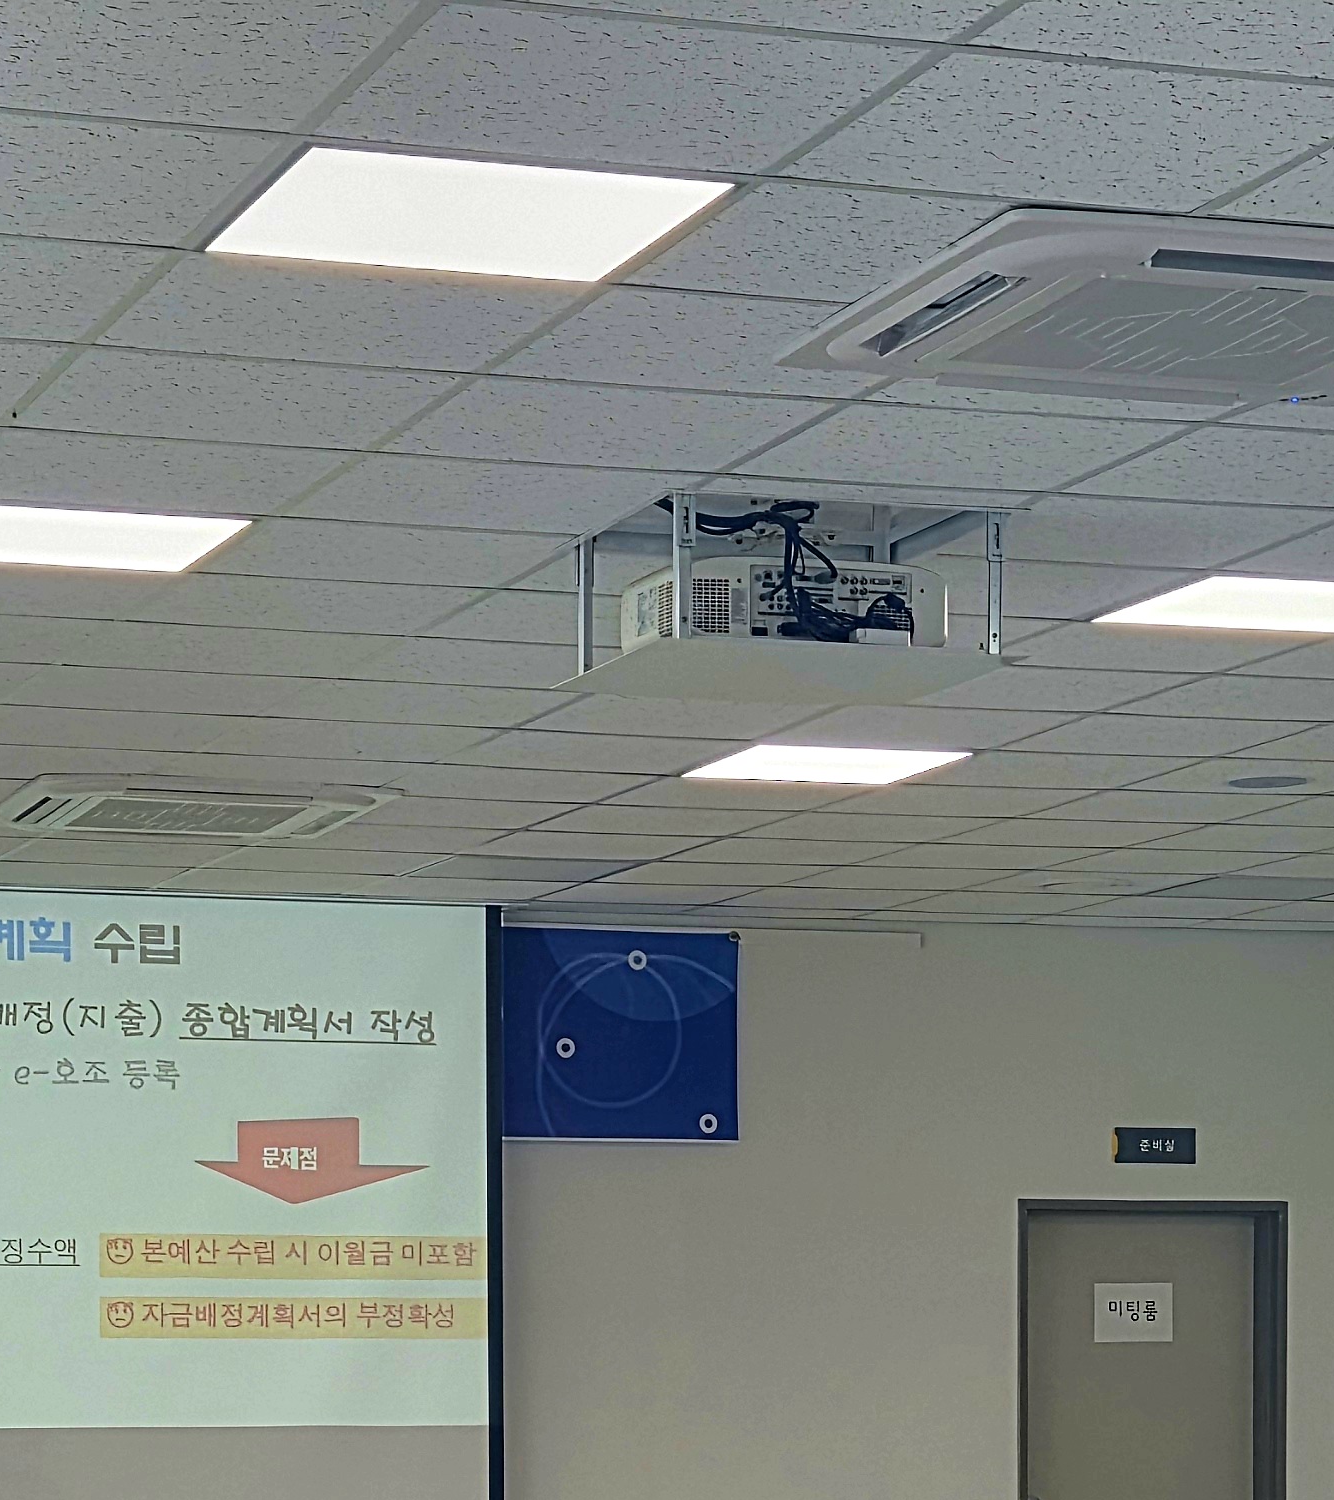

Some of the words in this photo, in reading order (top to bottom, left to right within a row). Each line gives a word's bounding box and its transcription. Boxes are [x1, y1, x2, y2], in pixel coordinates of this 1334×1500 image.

[94, 923, 181, 964] 수립
[182, 1002, 352, 1039] 종합계획서
[370, 1009, 435, 1043] 작성
[14, 1058, 110, 1085] e-호조
[122, 1059, 181, 1090] 등록
[262, 1146, 317, 1171] 문제점
[1139, 1139, 1175, 1152] 준비실
[1, 1237, 77, 1264] 징수액
[140, 1239, 220, 1265] 본예산
[227, 1239, 275, 1265] 수립
[285, 1240, 307, 1266] 시
[318, 1240, 394, 1266] 이월금
[402, 1240, 477, 1267] 미포함
[142, 1302, 347, 1329] 자금배정계획서의
[357, 1302, 454, 1329] 부정확성
[1108, 1300, 1158, 1322] 미팅룸
